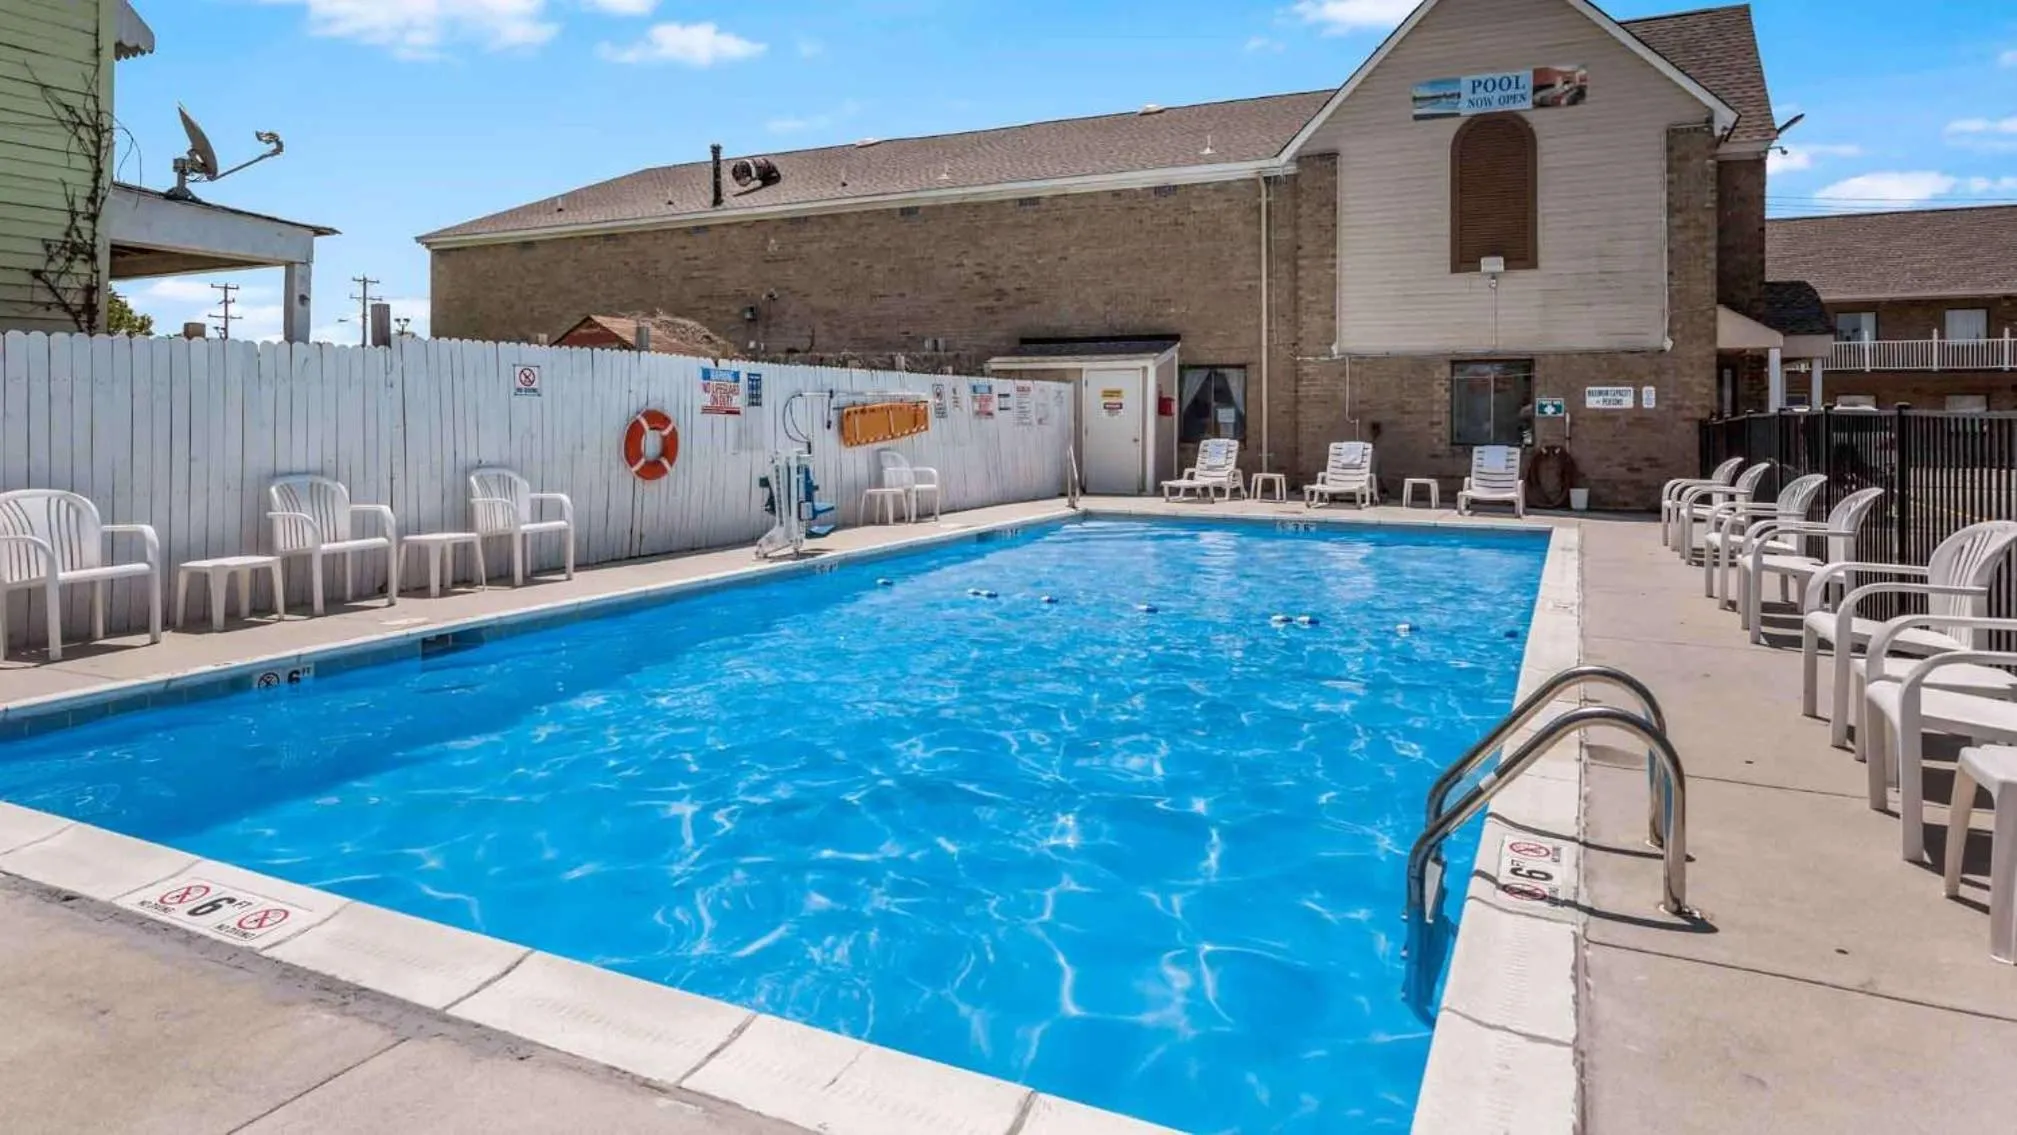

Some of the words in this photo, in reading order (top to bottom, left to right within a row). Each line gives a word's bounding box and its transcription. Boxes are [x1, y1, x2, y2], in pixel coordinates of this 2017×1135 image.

[1471, 75, 1526, 95] POOL
[1466, 94, 1494, 109] NOW
[1498, 93, 1527, 106] OPEN
[288, 670, 301, 684] 6
[1510, 867, 1553, 880] 6
[187, 897, 236, 916] 6
